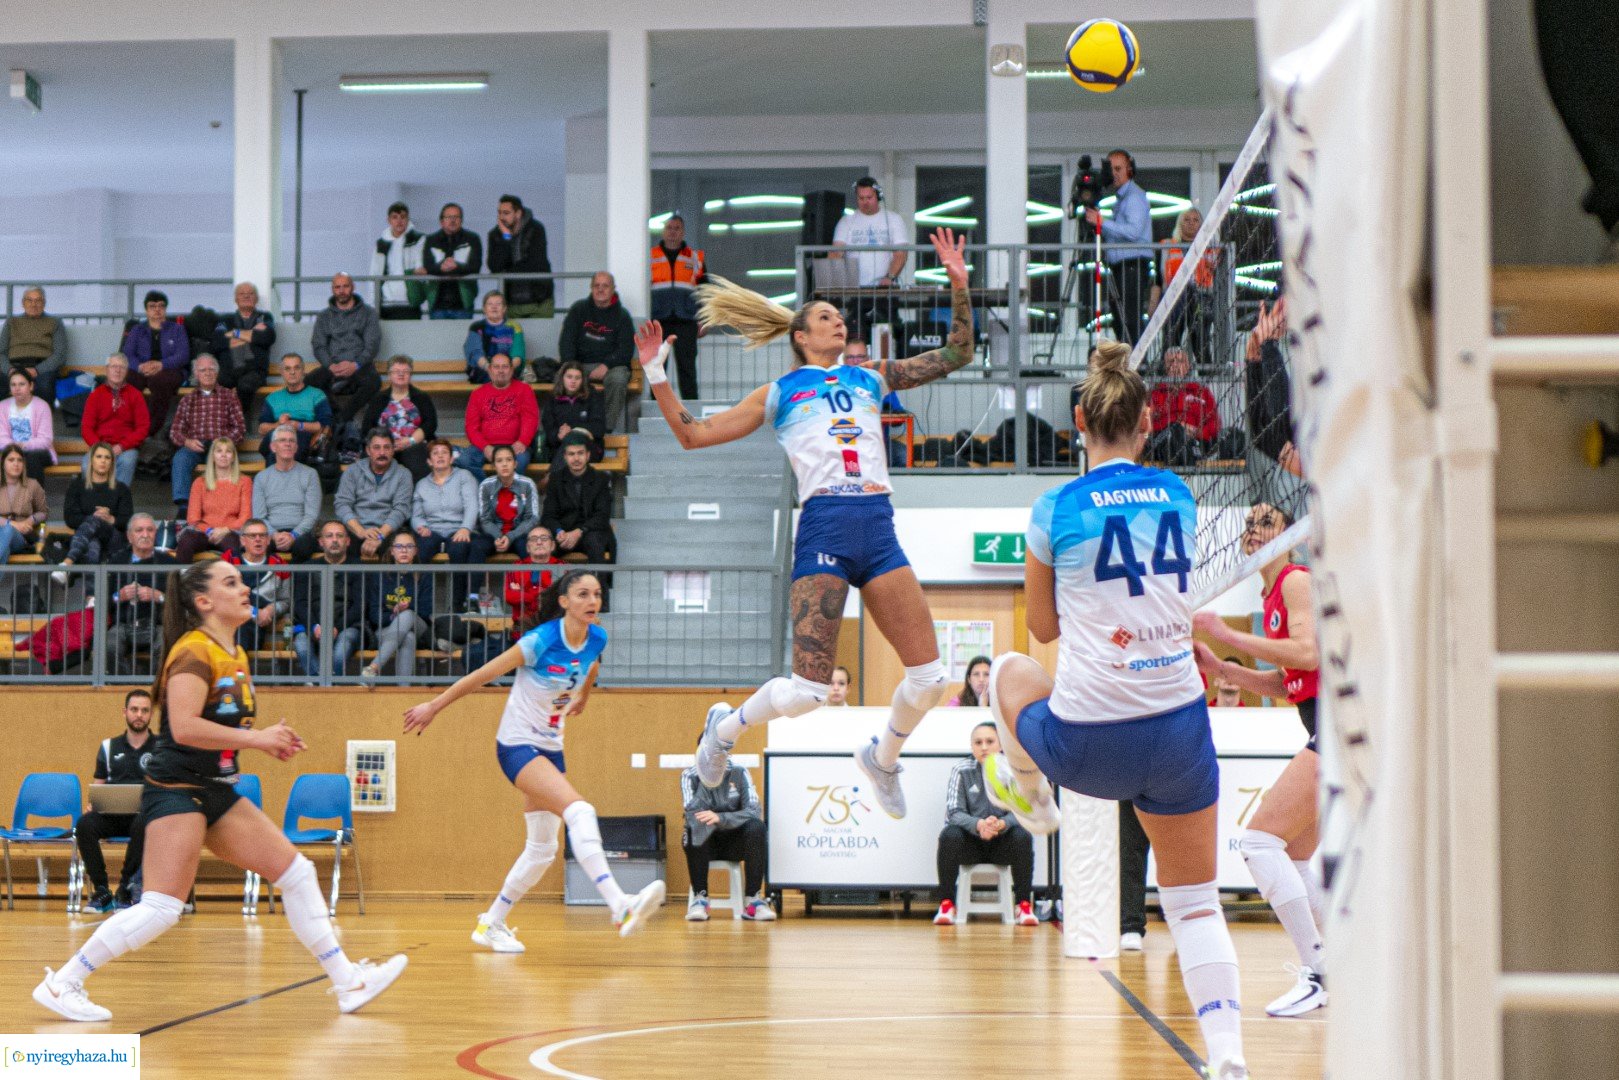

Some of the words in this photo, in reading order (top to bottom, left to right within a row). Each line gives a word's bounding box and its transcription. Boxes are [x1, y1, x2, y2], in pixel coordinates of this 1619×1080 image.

[909, 334, 942, 345] ALTO
[822, 390, 853, 414] 10
[1090, 487, 1171, 508] BAGYINKA
[1094, 510, 1191, 597] 44
[566, 671, 579, 690] 5
[797, 832, 879, 849] RÖPLABDA
